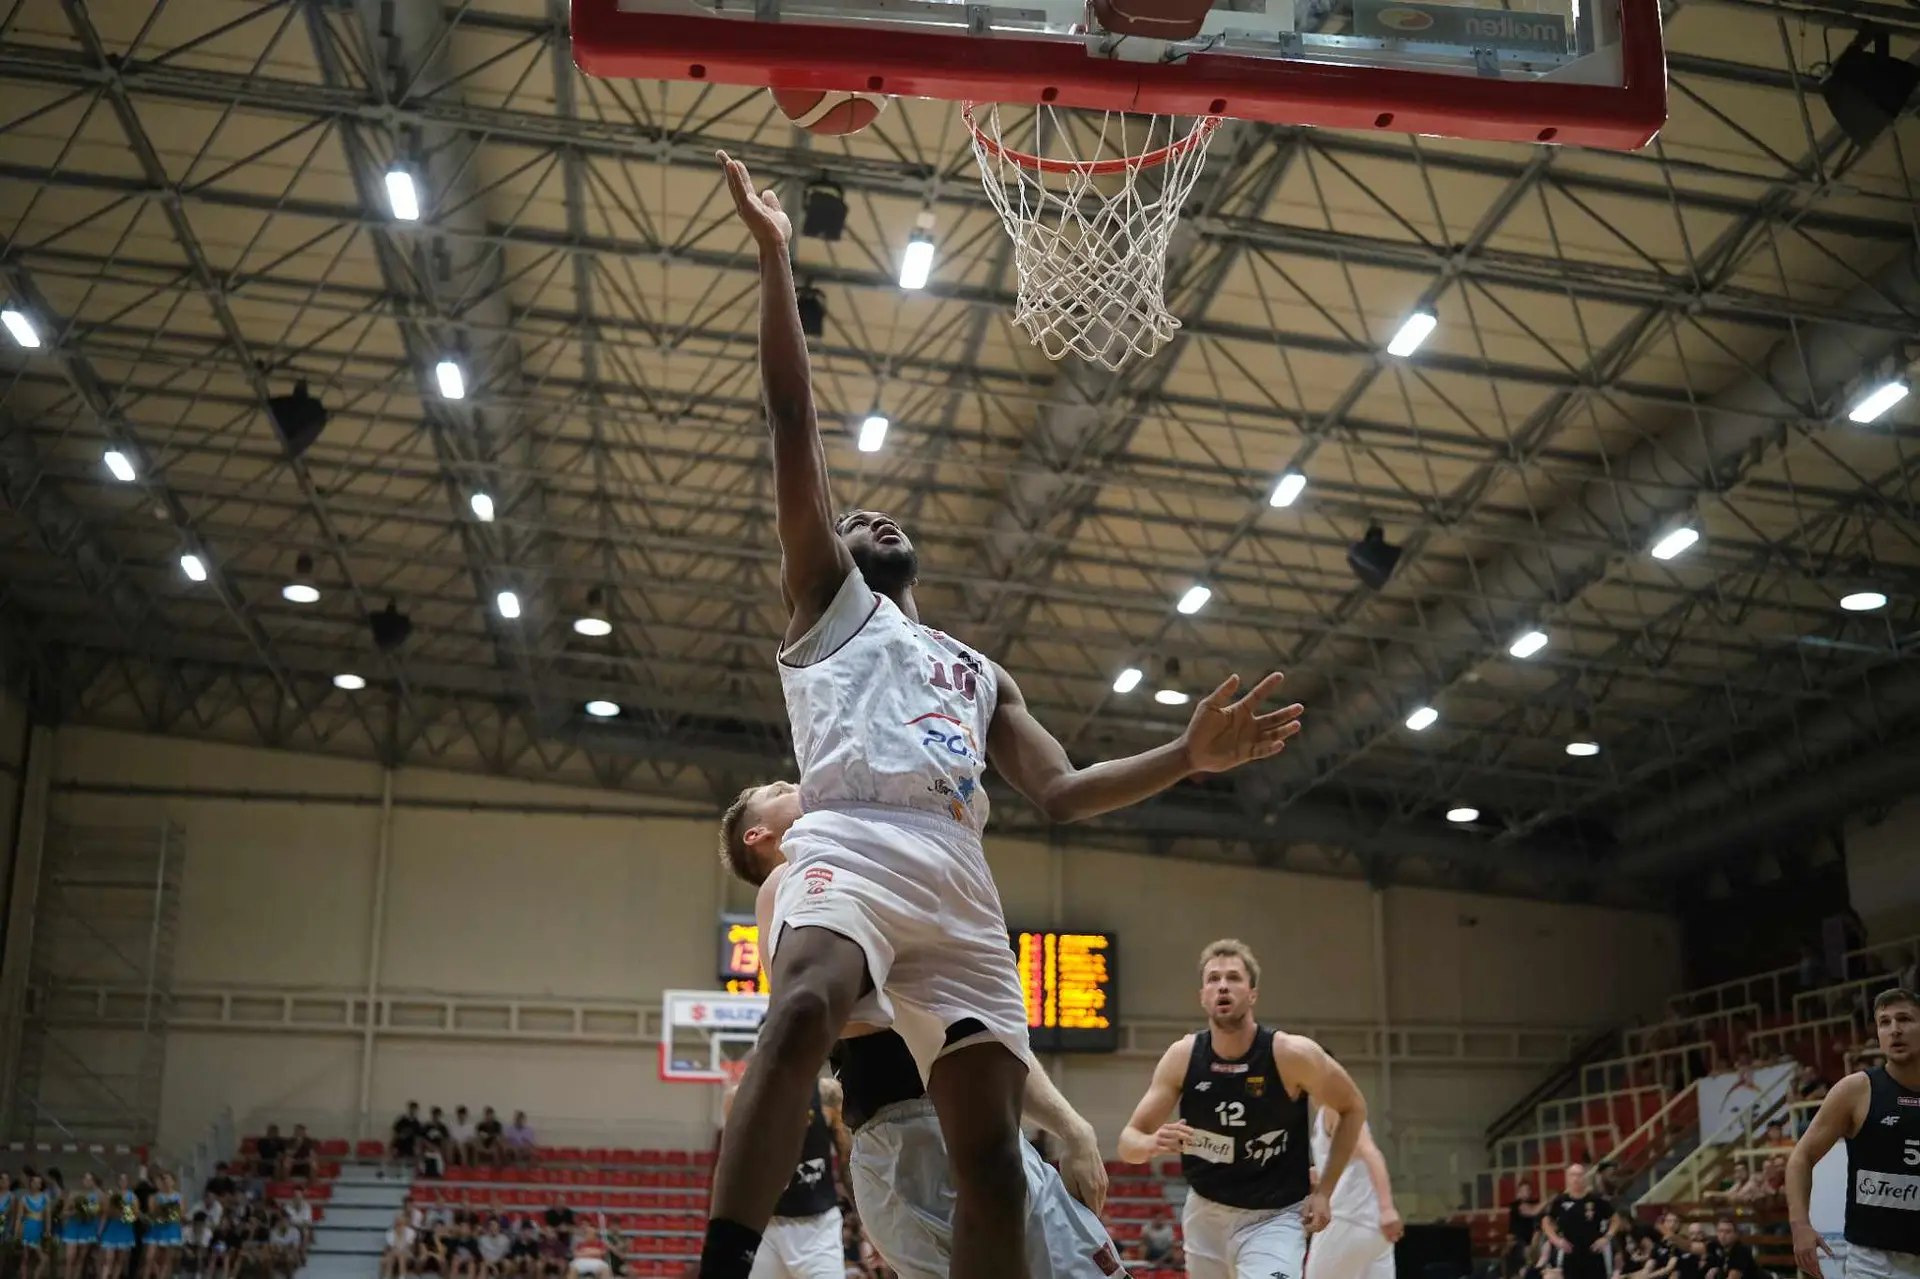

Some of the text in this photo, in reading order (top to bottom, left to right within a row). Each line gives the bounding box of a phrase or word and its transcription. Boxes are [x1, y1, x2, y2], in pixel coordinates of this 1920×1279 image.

[927, 653, 977, 701] 10
[1214, 1101, 1247, 1127] 12
[1880, 1115, 1900, 1126] 4F
[1877, 1180, 1918, 1202] Trefl
